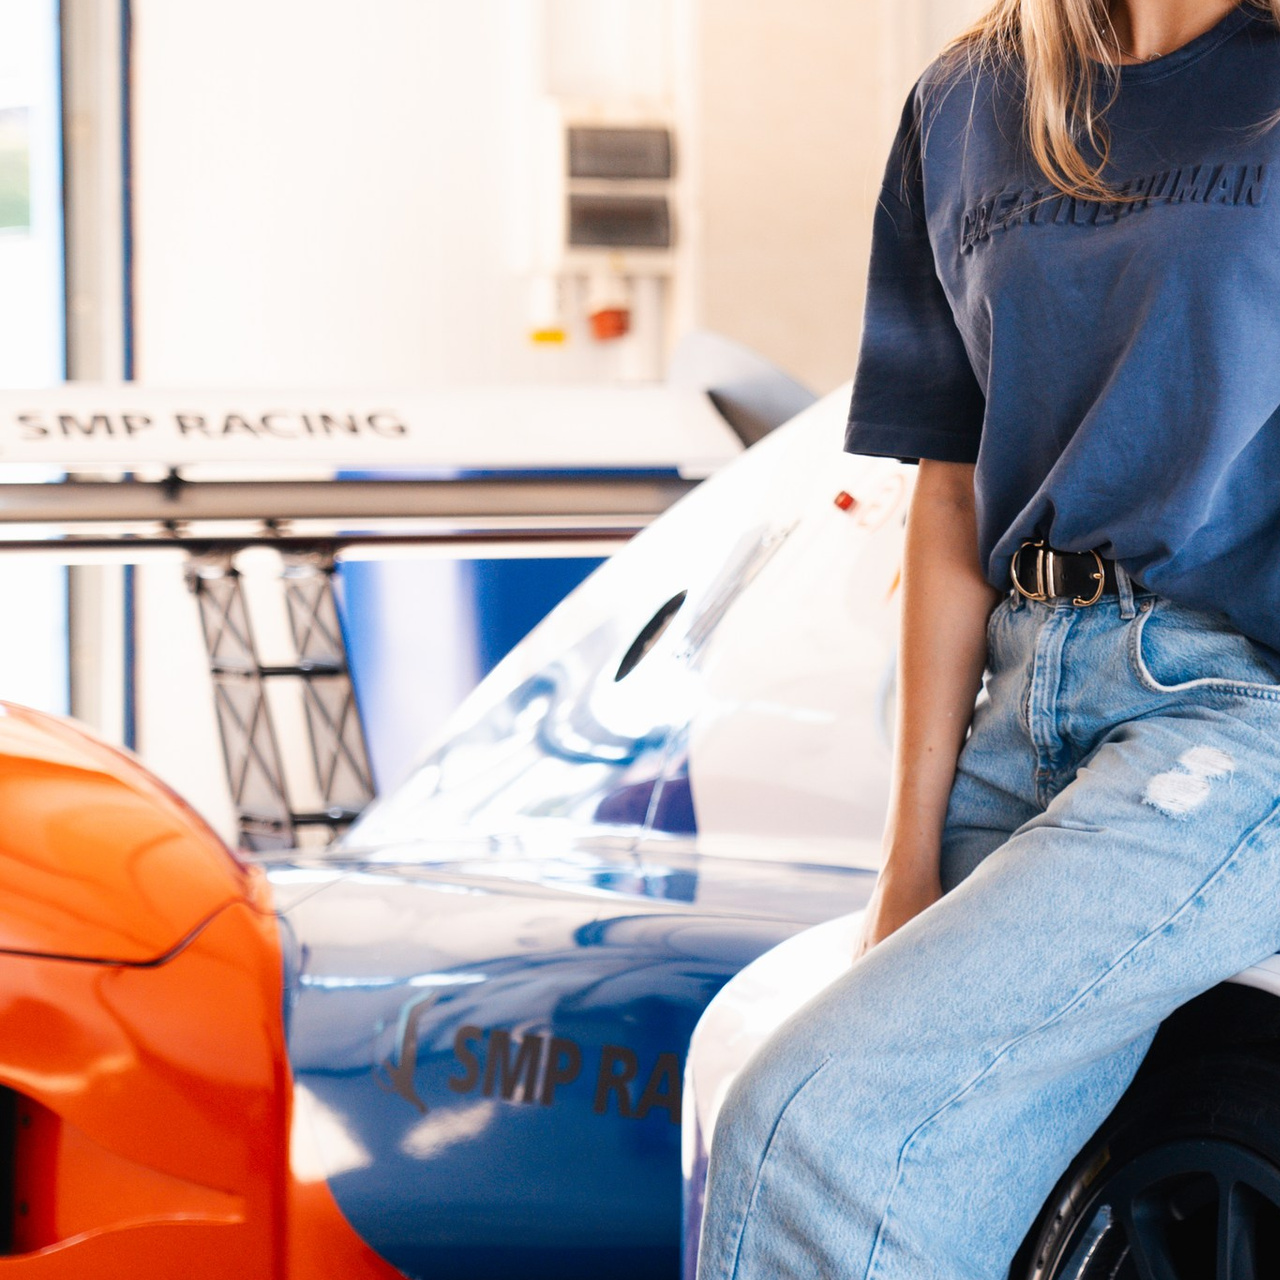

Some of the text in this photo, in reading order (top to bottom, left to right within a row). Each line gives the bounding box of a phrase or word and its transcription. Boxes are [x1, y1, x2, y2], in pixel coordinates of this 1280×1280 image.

[17, 411, 408, 440] SMP RACING
[449, 1025, 581, 1106] SMP
